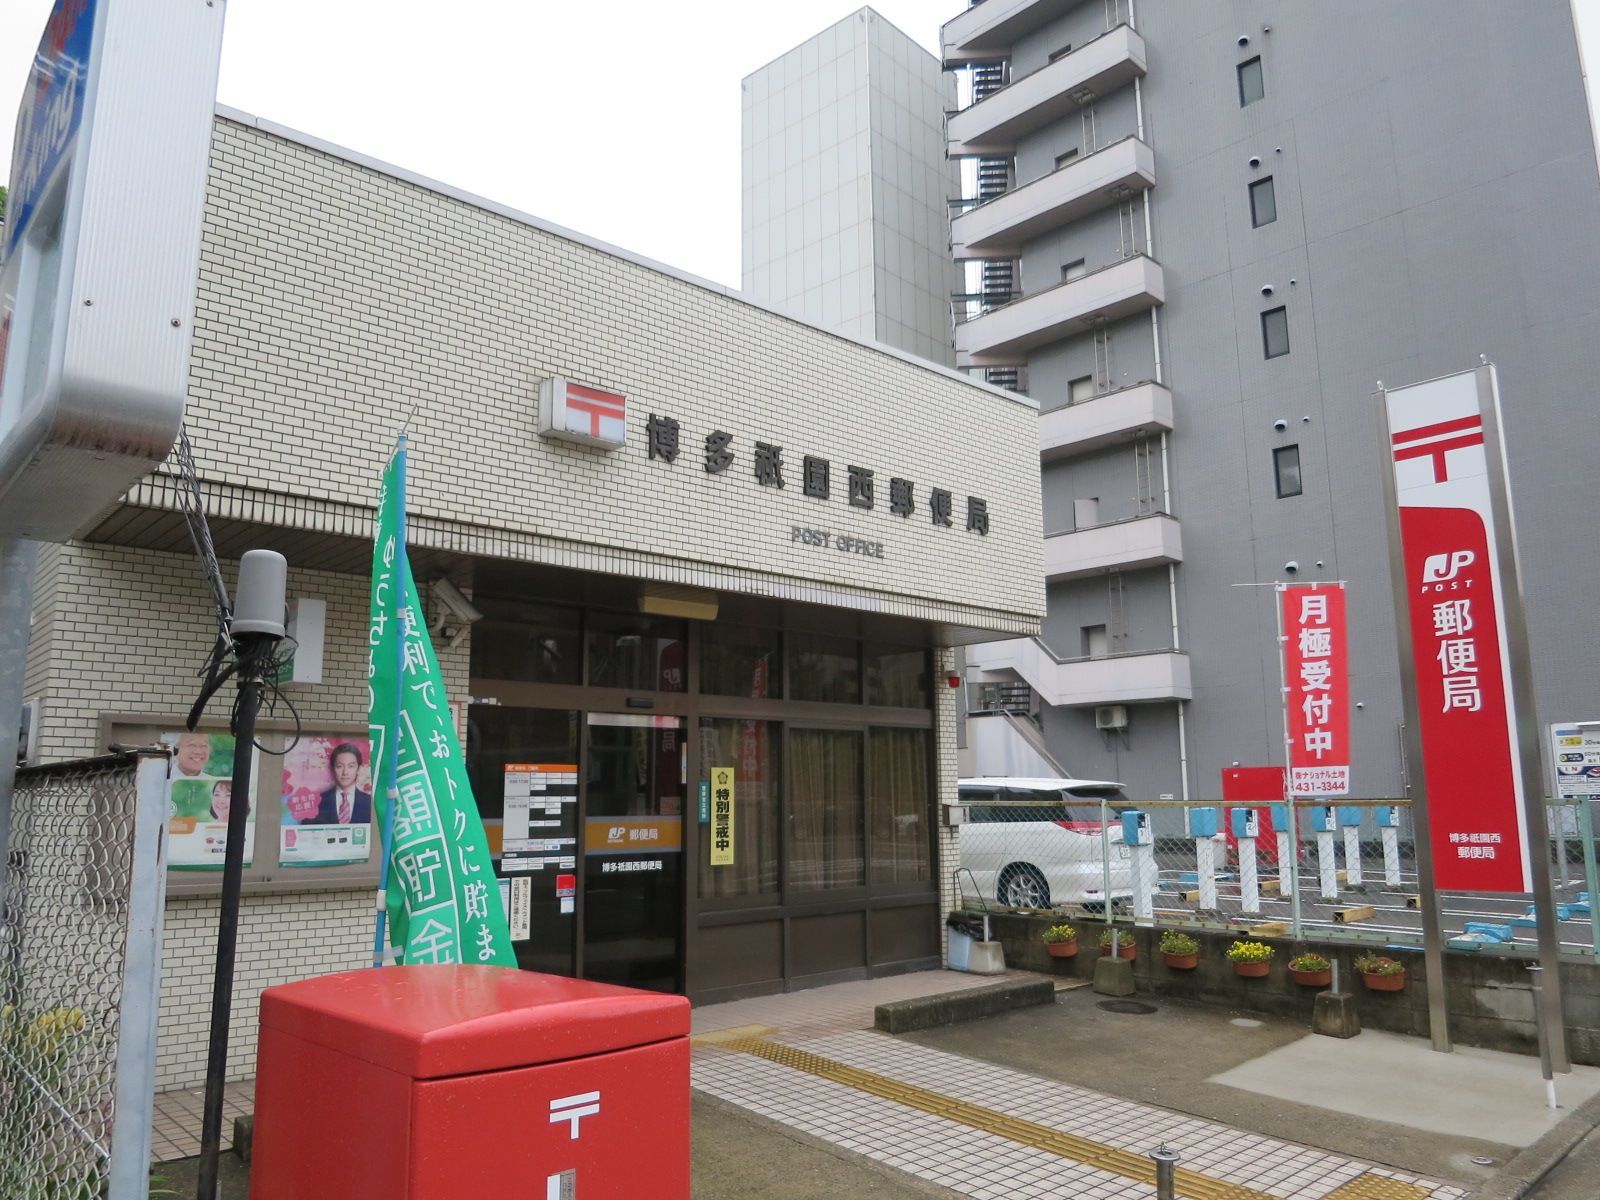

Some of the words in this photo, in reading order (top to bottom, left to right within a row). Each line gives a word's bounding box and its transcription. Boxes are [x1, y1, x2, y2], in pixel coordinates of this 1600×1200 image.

[646, 413, 989, 536] 博多祇園西郵便局
[791, 526, 831, 548] POST
[835, 533, 885, 559] OFFICE
[1422, 550, 1475, 583] JP
[1421, 579, 1473, 594] POST
[1432, 599, 1482, 713] 郵便局
[1299, 595, 1332, 759] 月極受付中
[1295, 781, 1345, 792] 431-3344
[629, 828, 658, 841] 郵便局
[715, 788, 730, 851] 特別警戒中
[1457, 846, 1496, 859] 郵便局
